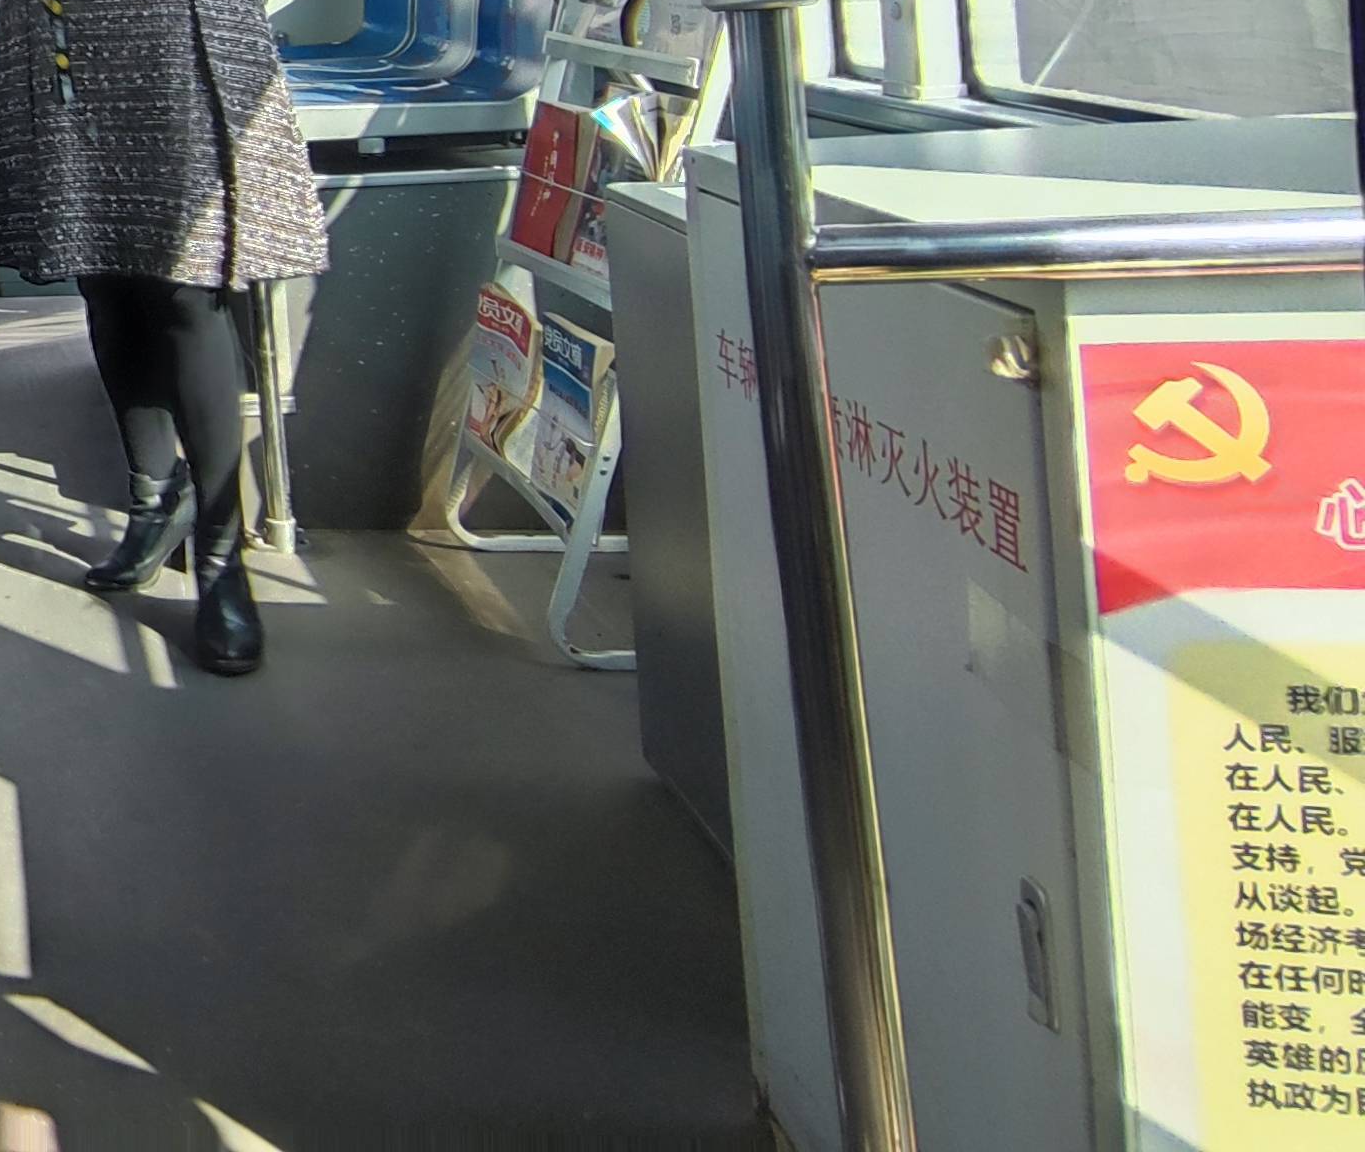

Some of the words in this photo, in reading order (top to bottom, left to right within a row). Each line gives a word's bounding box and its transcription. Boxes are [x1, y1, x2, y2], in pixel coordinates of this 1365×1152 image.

[1286, 685, 1365, 716] 我们
[1224, 723, 1365, 756] 人民、服
[1234, 881, 1354, 917] 从谈起。
[1243, 1039, 1365, 1077] 英雄的
[1246, 1078, 1365, 1116] 执政为
